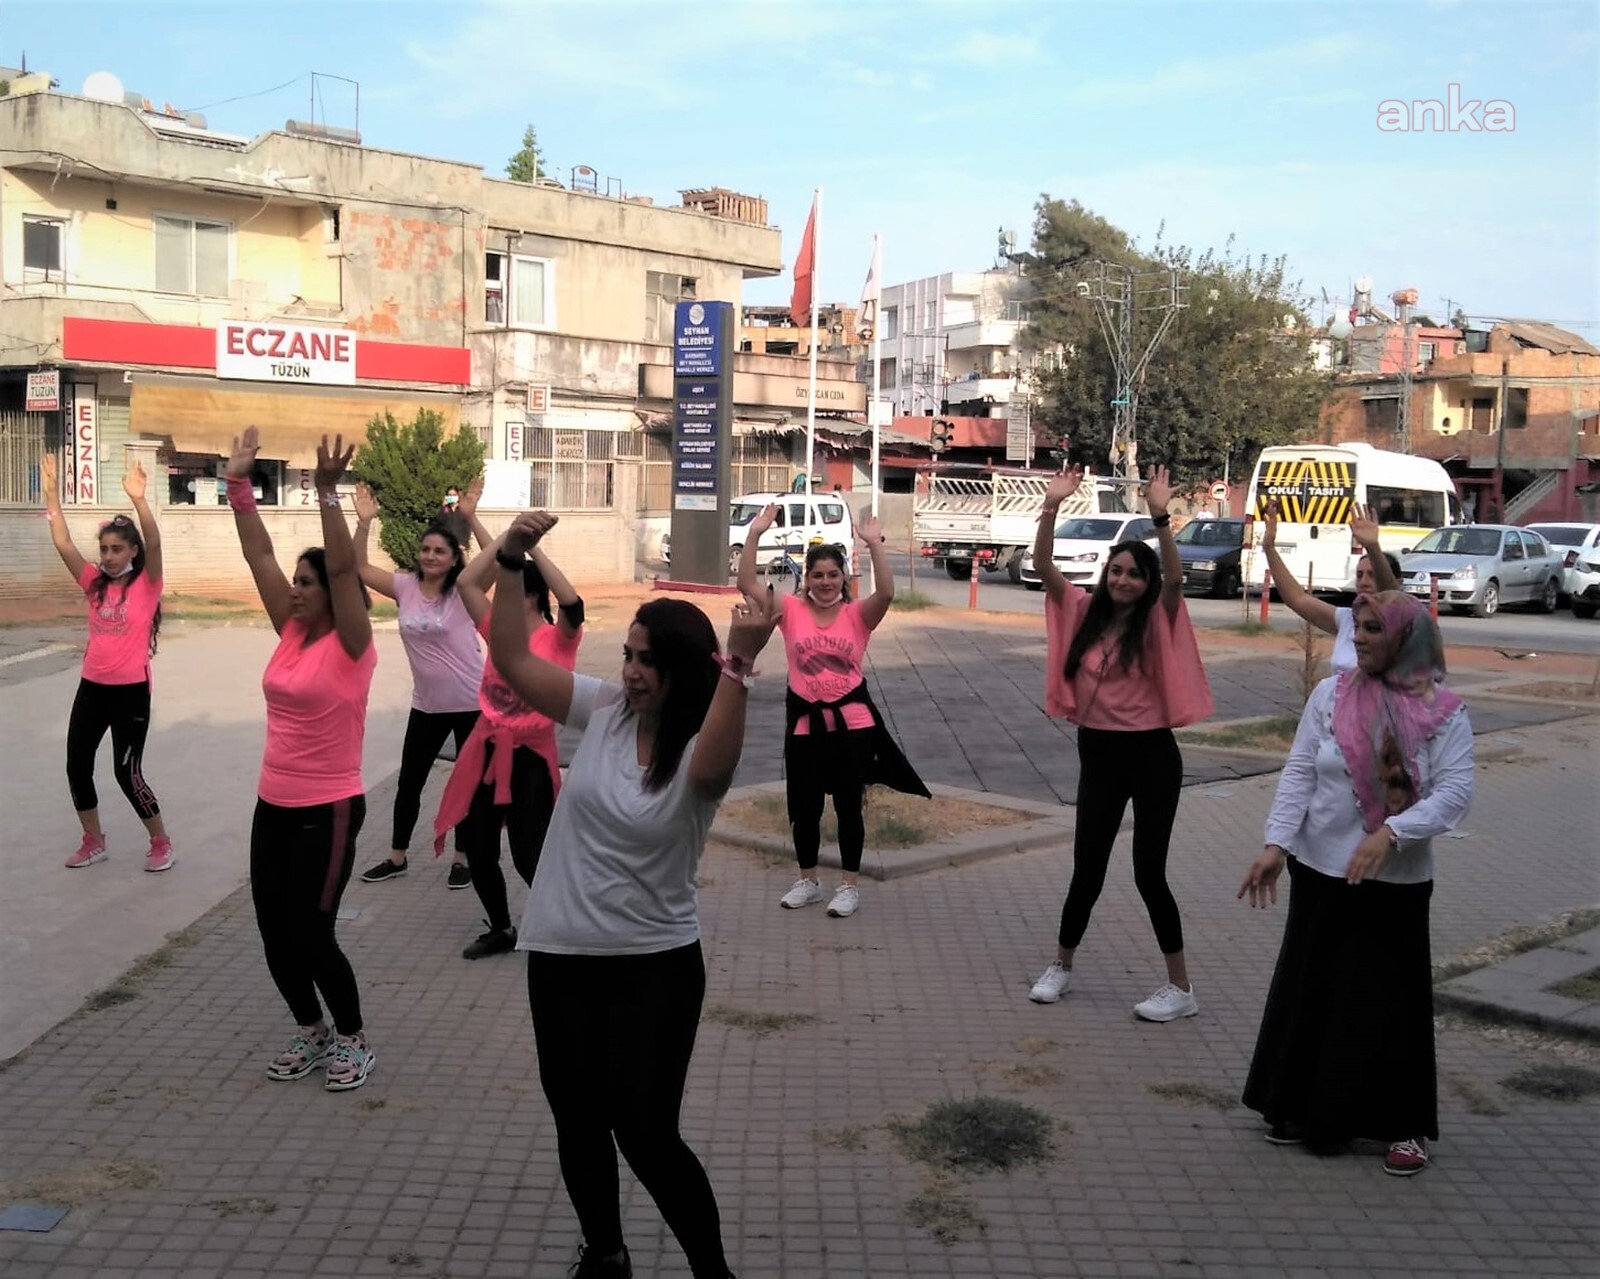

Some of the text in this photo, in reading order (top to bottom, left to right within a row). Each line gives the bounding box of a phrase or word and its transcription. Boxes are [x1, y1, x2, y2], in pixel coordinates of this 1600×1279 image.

[684, 327, 710, 336] SEYHAN
[227, 326, 350, 362] ECZANE
[678, 335, 715, 346] BELEDİYESİ
[270, 361, 310, 378] TÜZÜN
[30, 375, 56, 386] ECZANE
[533, 390, 543, 407] E
[1267, 486, 1303, 495] OKUL
